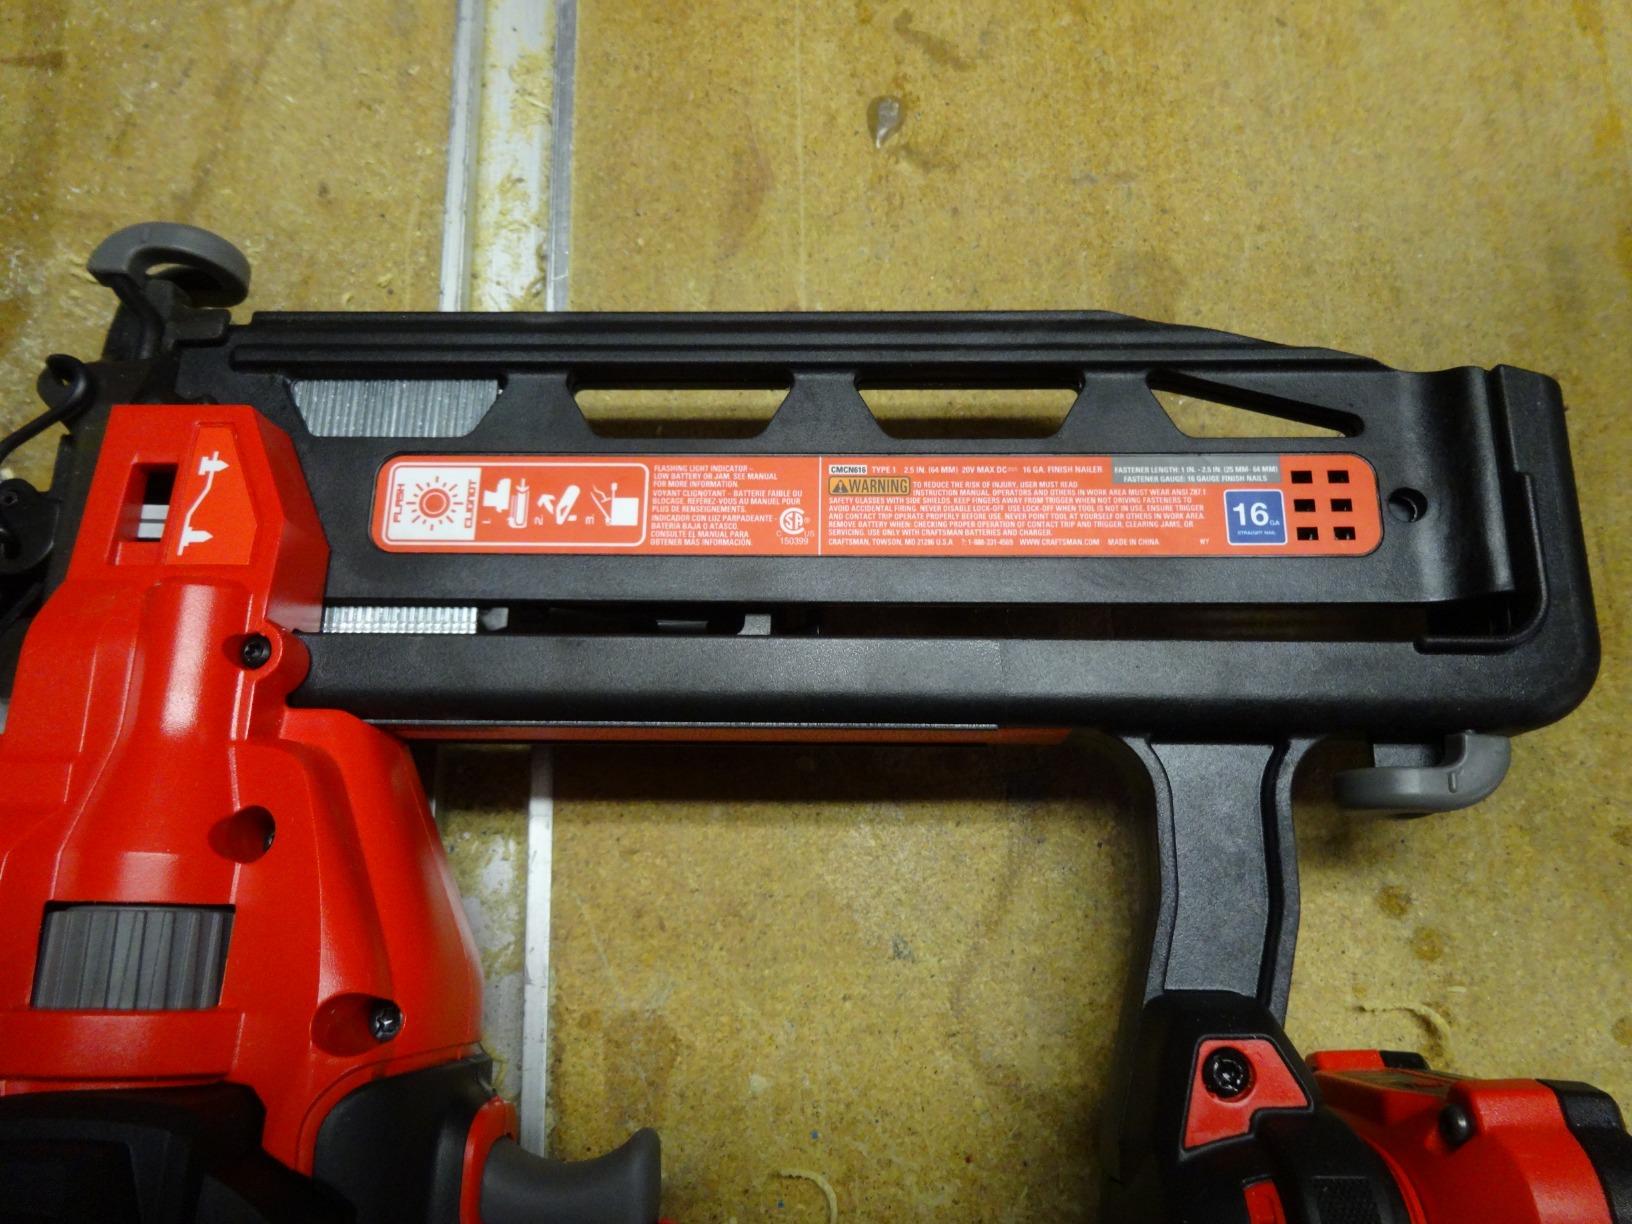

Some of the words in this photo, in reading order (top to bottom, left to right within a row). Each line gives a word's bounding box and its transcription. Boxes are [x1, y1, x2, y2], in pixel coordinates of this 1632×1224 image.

[849, 479, 908, 493] WARNING
[393, 483, 405, 523] FLASH
[1232, 502, 1269, 526] 16
